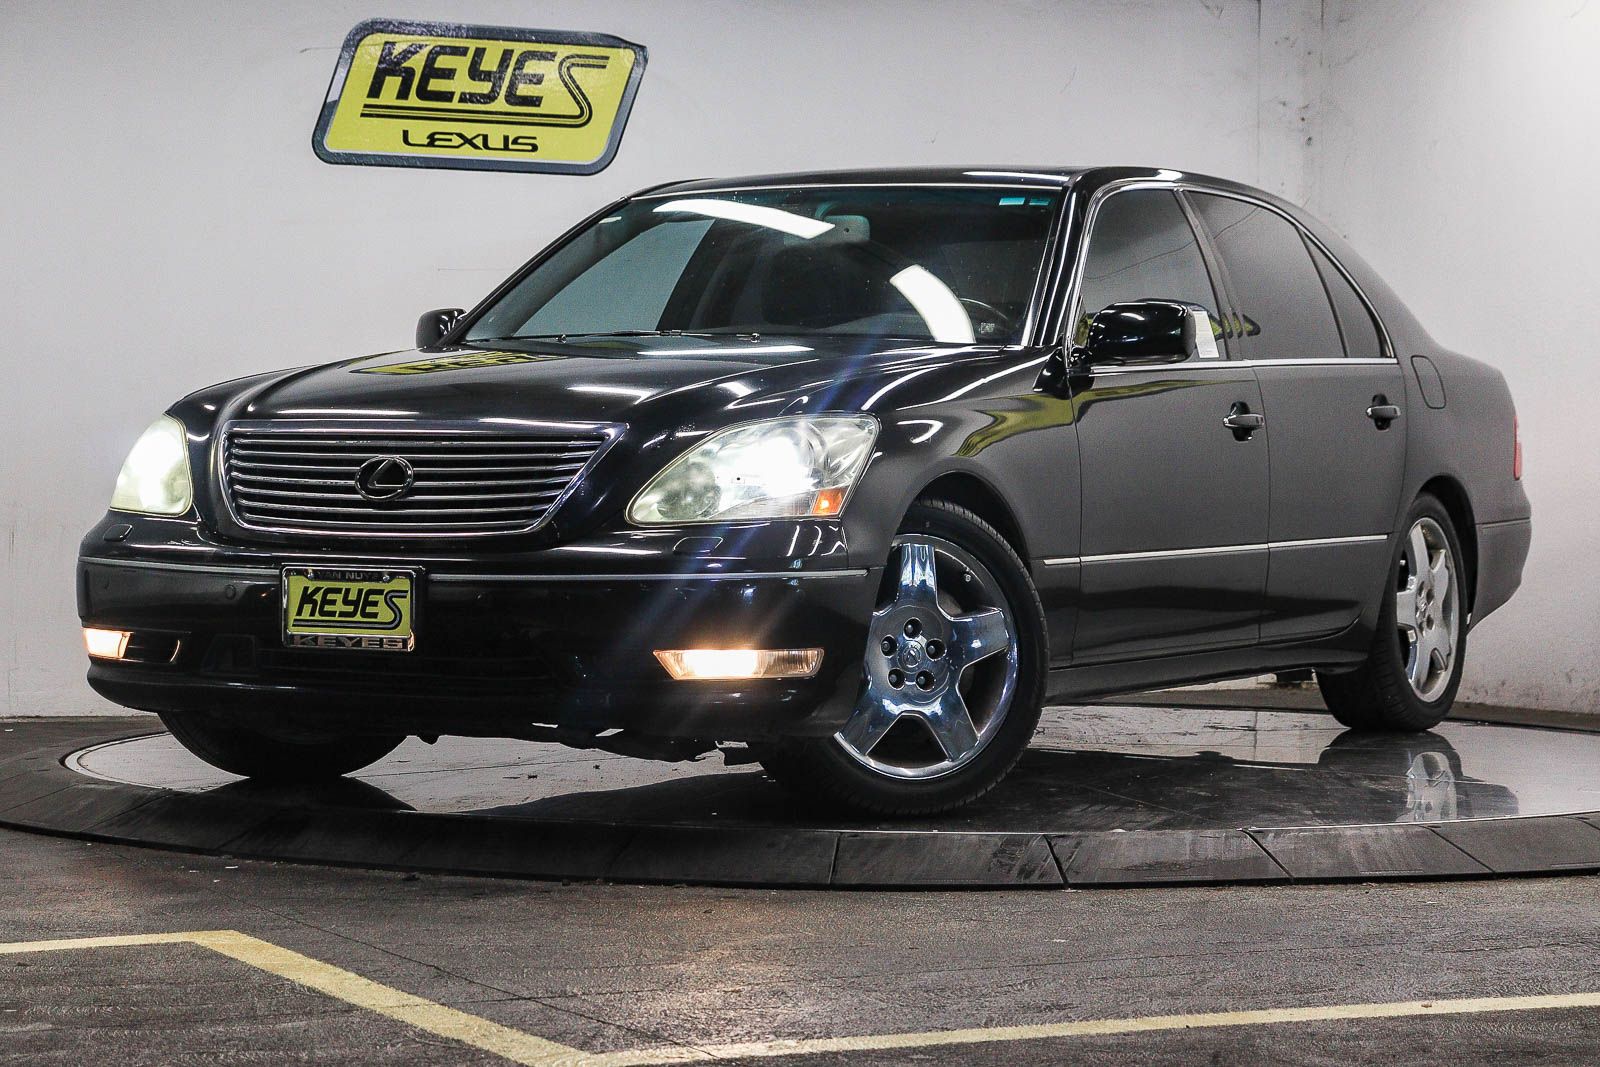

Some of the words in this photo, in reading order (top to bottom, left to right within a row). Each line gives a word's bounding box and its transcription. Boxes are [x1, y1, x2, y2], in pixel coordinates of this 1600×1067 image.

[361, 41, 610, 128] KEYES
[402, 129, 539, 153] LEXUS
[292, 586, 409, 630] KEYES
[293, 635, 403, 649] KEYES
